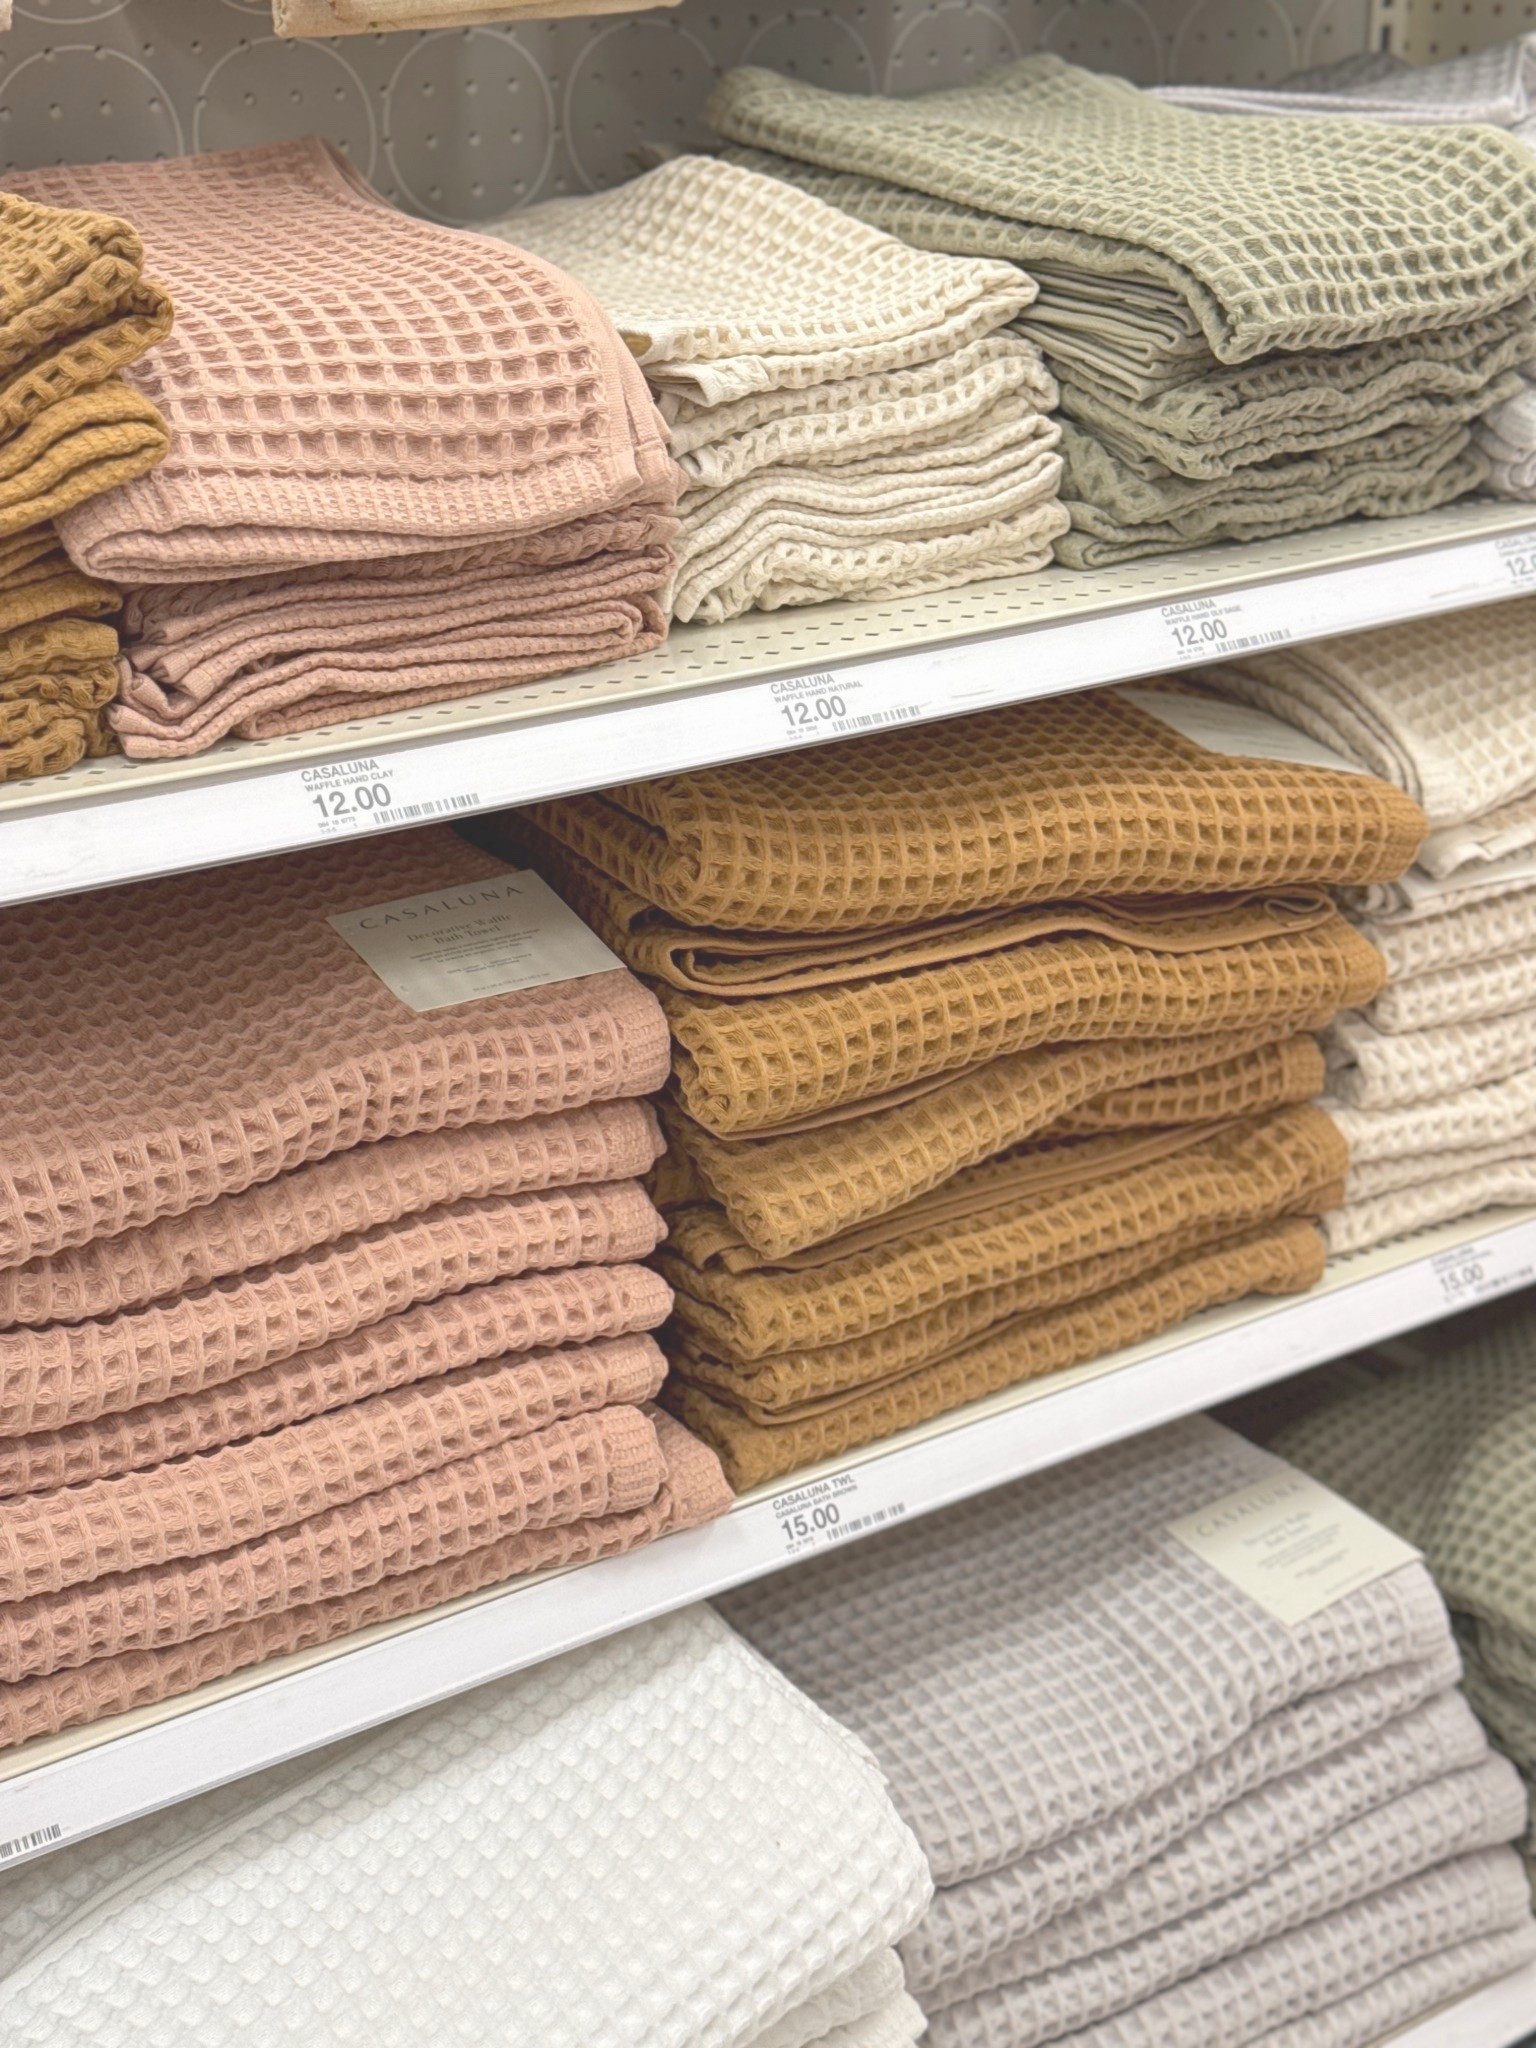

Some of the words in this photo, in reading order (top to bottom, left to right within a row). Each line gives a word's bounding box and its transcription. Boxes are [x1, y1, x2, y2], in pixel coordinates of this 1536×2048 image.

[1161, 599, 1217, 618] CASALUNA
[1171, 619, 1227, 647] 12.00
[770, 673, 835, 694] CASALUNA
[774, 693, 804, 703] WAFFLE
[806, 688, 827, 698] HAND
[828, 680, 863, 693] NATURAL
[781, 695, 847, 726] 12.00
[301, 759, 379, 782] CASALUNA
[305, 780, 342, 792] WAFFLE
[344, 775, 369, 786] HAND
[371, 769, 393, 780] CLAY
[312, 783, 391, 818] 12.00
[359, 886, 523, 930] CASALUNA
[406, 923, 472, 942] Decorative
[434, 933, 464, 945] Bath
[467, 924, 501, 937] Towel
[773, 1482, 830, 1510] CASALUNA
[831, 1474, 856, 1489] TWL
[775, 1500, 812, 1519] CASALUNA
[813, 1493, 831, 1506] BATH
[782, 1503, 840, 1540] 15.00
